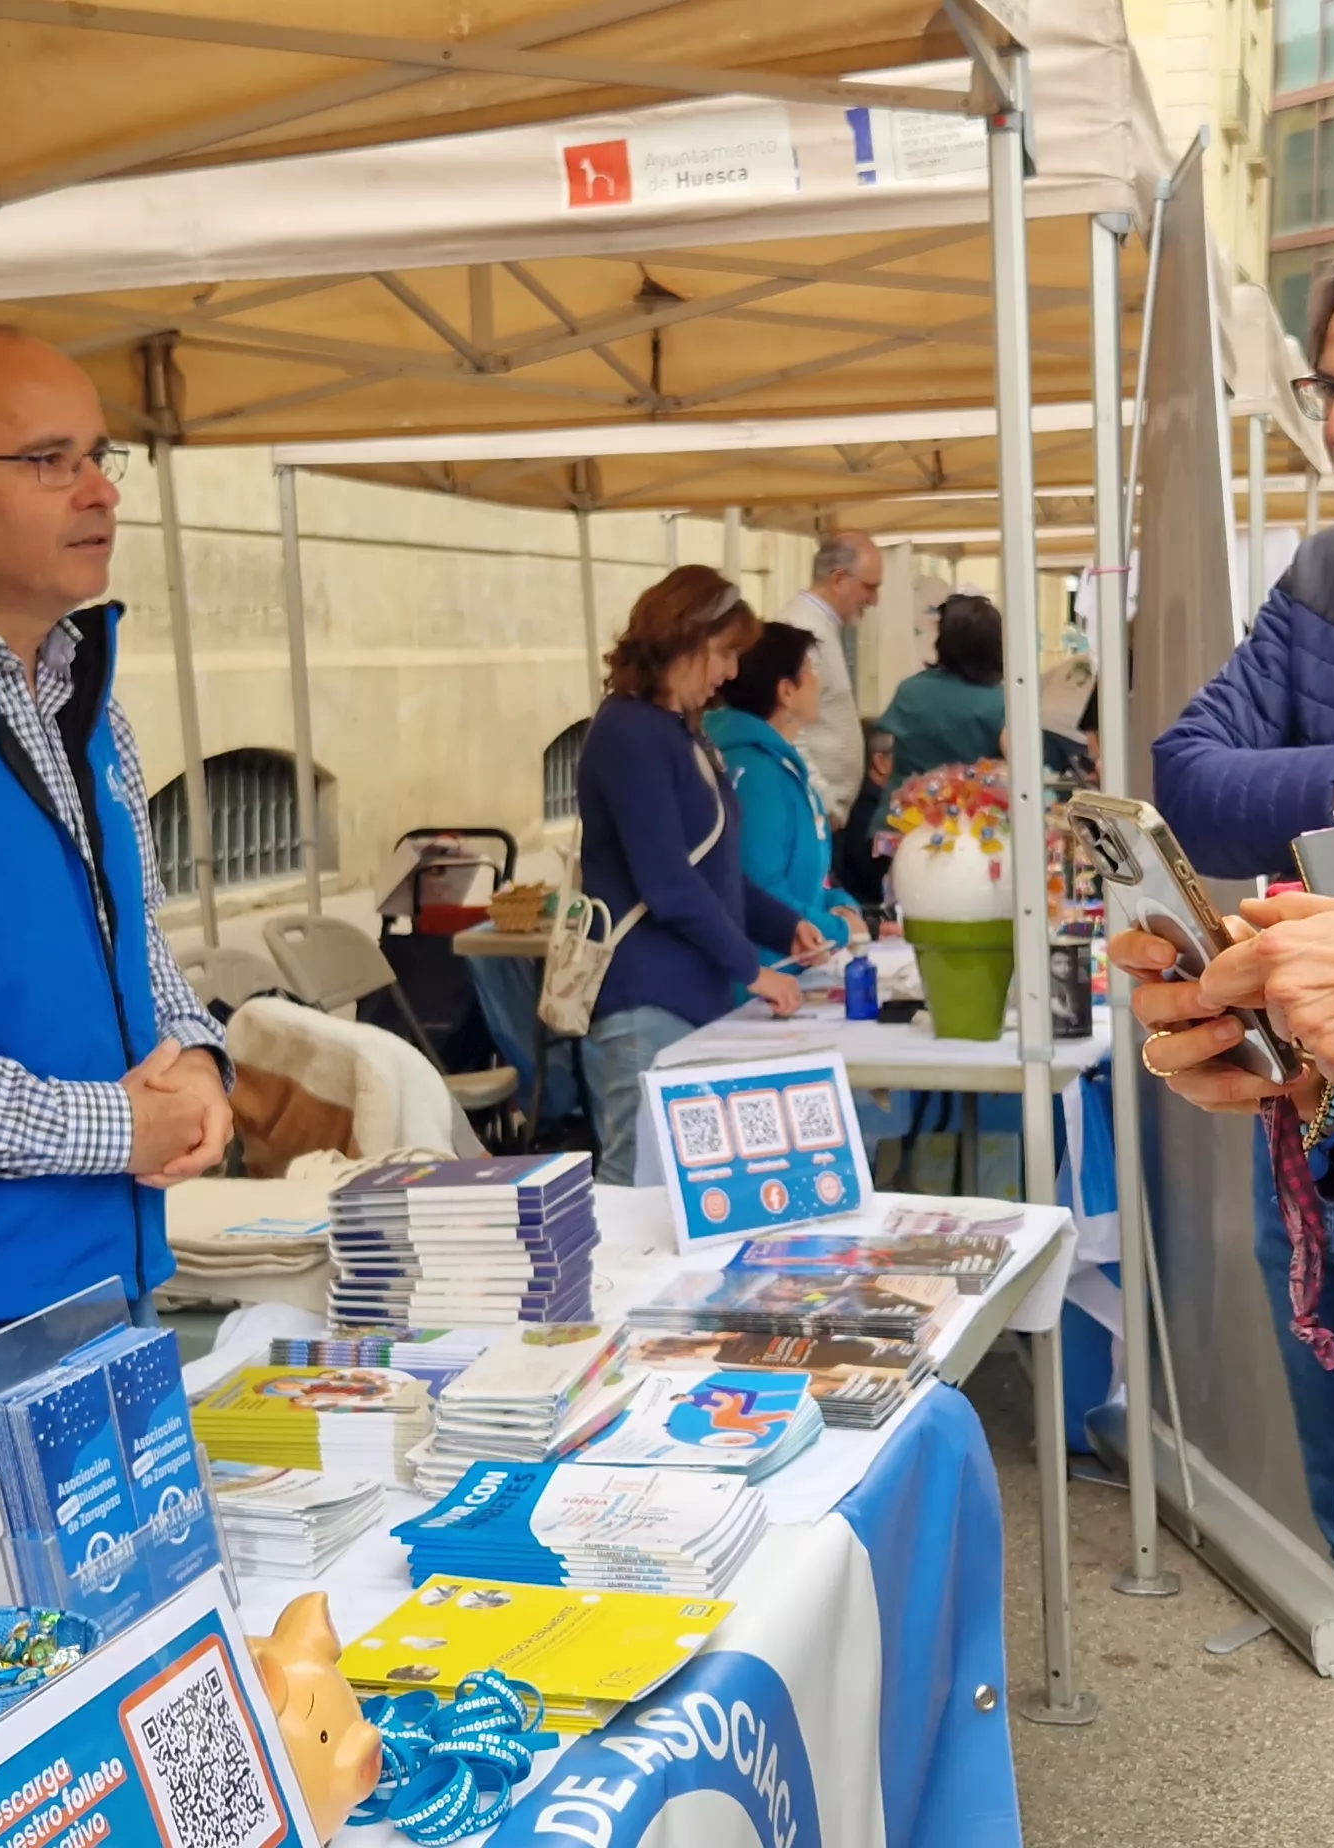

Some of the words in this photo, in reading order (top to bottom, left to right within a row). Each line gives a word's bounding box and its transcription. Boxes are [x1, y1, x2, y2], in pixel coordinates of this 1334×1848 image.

[645, 139, 778, 172] Ayuntamiento
[648, 175, 670, 192] de
[676, 167, 748, 188] Huesca
[133, 1416, 183, 1453] Asociación
[152, 1433, 187, 1462] Diabetes
[58, 1457, 111, 1499] Asociación
[141, 1473, 153, 1489] de
[152, 1451, 192, 1482] Zaragoza
[464, 1470, 509, 1505] CON
[78, 1475, 117, 1506] Diabetes
[67, 1520, 80, 1536] de
[78, 1493, 121, 1527] Zaragoza
[61, 1757, 123, 1815] folleto
[535, 1775, 637, 1848] DE
[601, 1692, 797, 1848] ASOCIACI
